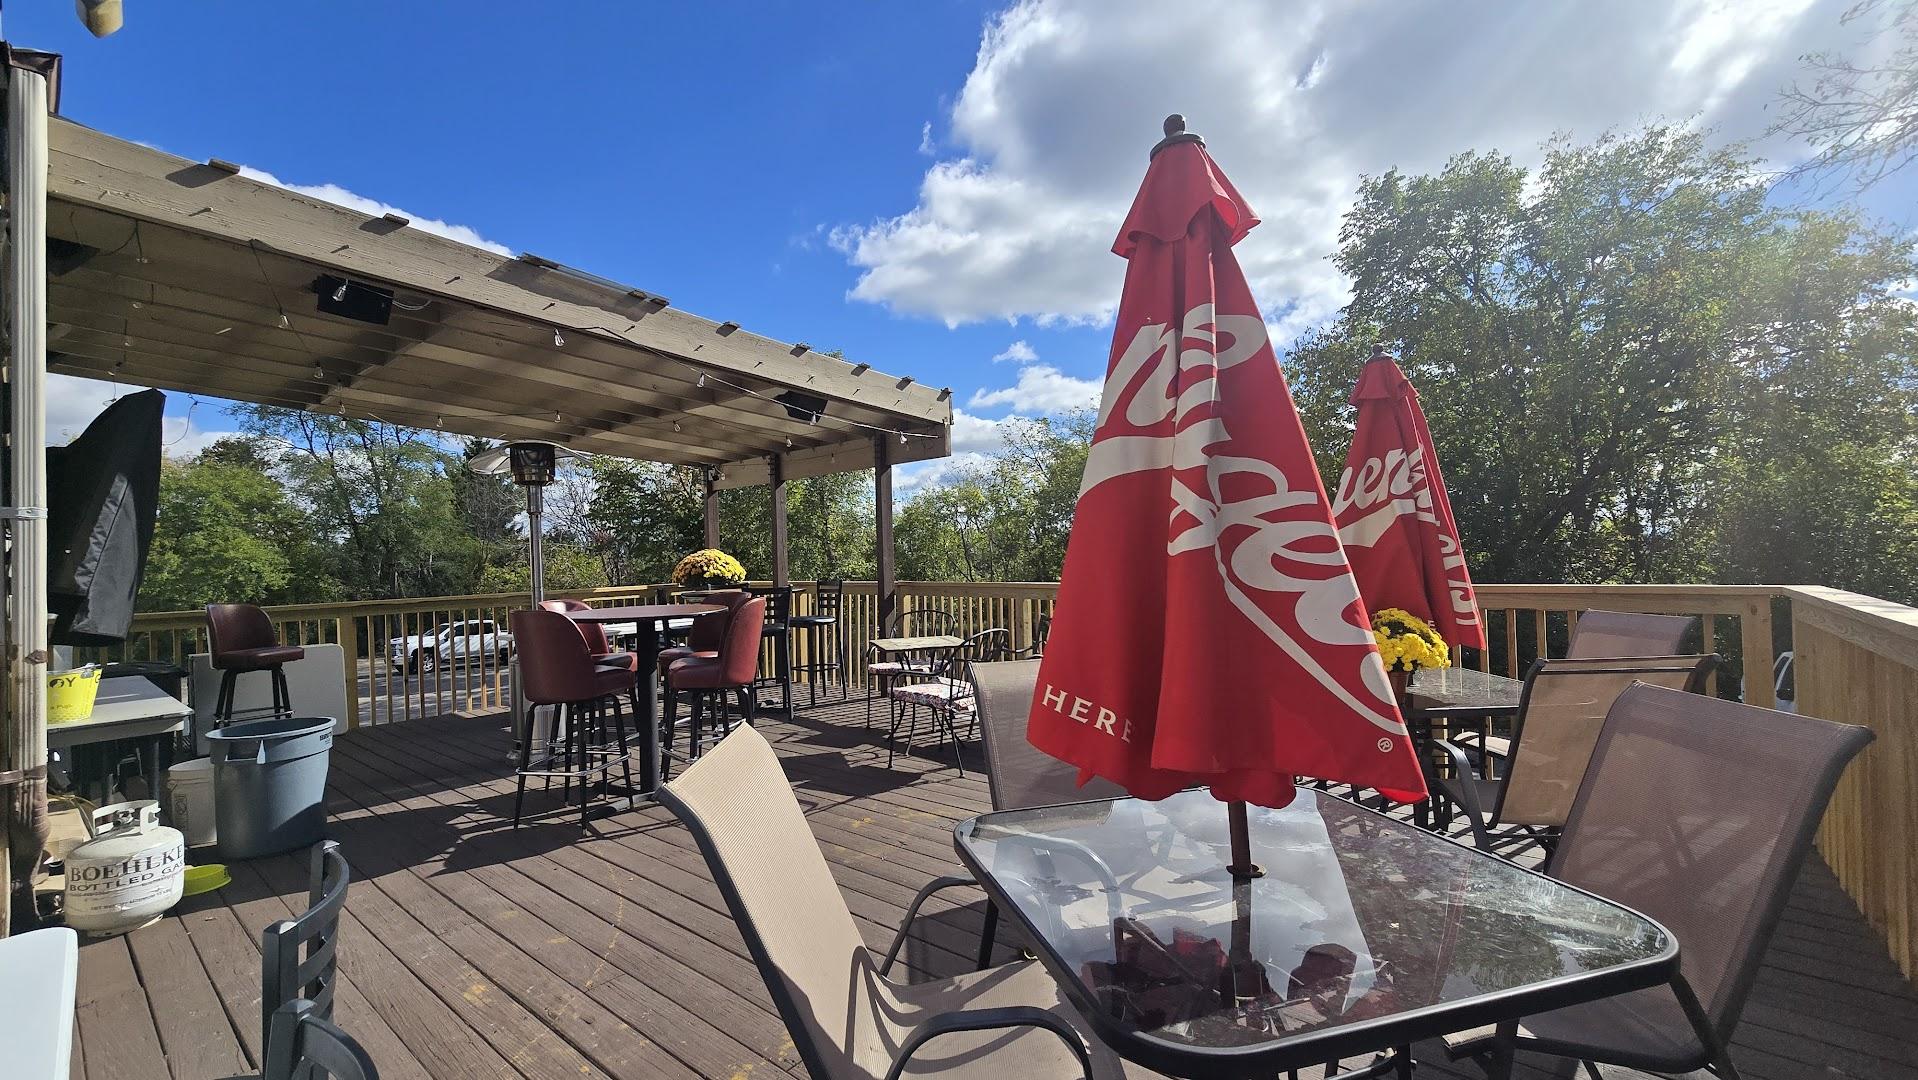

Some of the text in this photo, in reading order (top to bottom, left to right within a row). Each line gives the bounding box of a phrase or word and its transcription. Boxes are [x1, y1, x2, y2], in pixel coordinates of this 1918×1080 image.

[1042, 684, 1132, 743] HERE
[69, 873, 155, 892] BOTTLED
[162, 861, 185, 874] GAS
[71, 844, 184, 882] BOEHLKE
